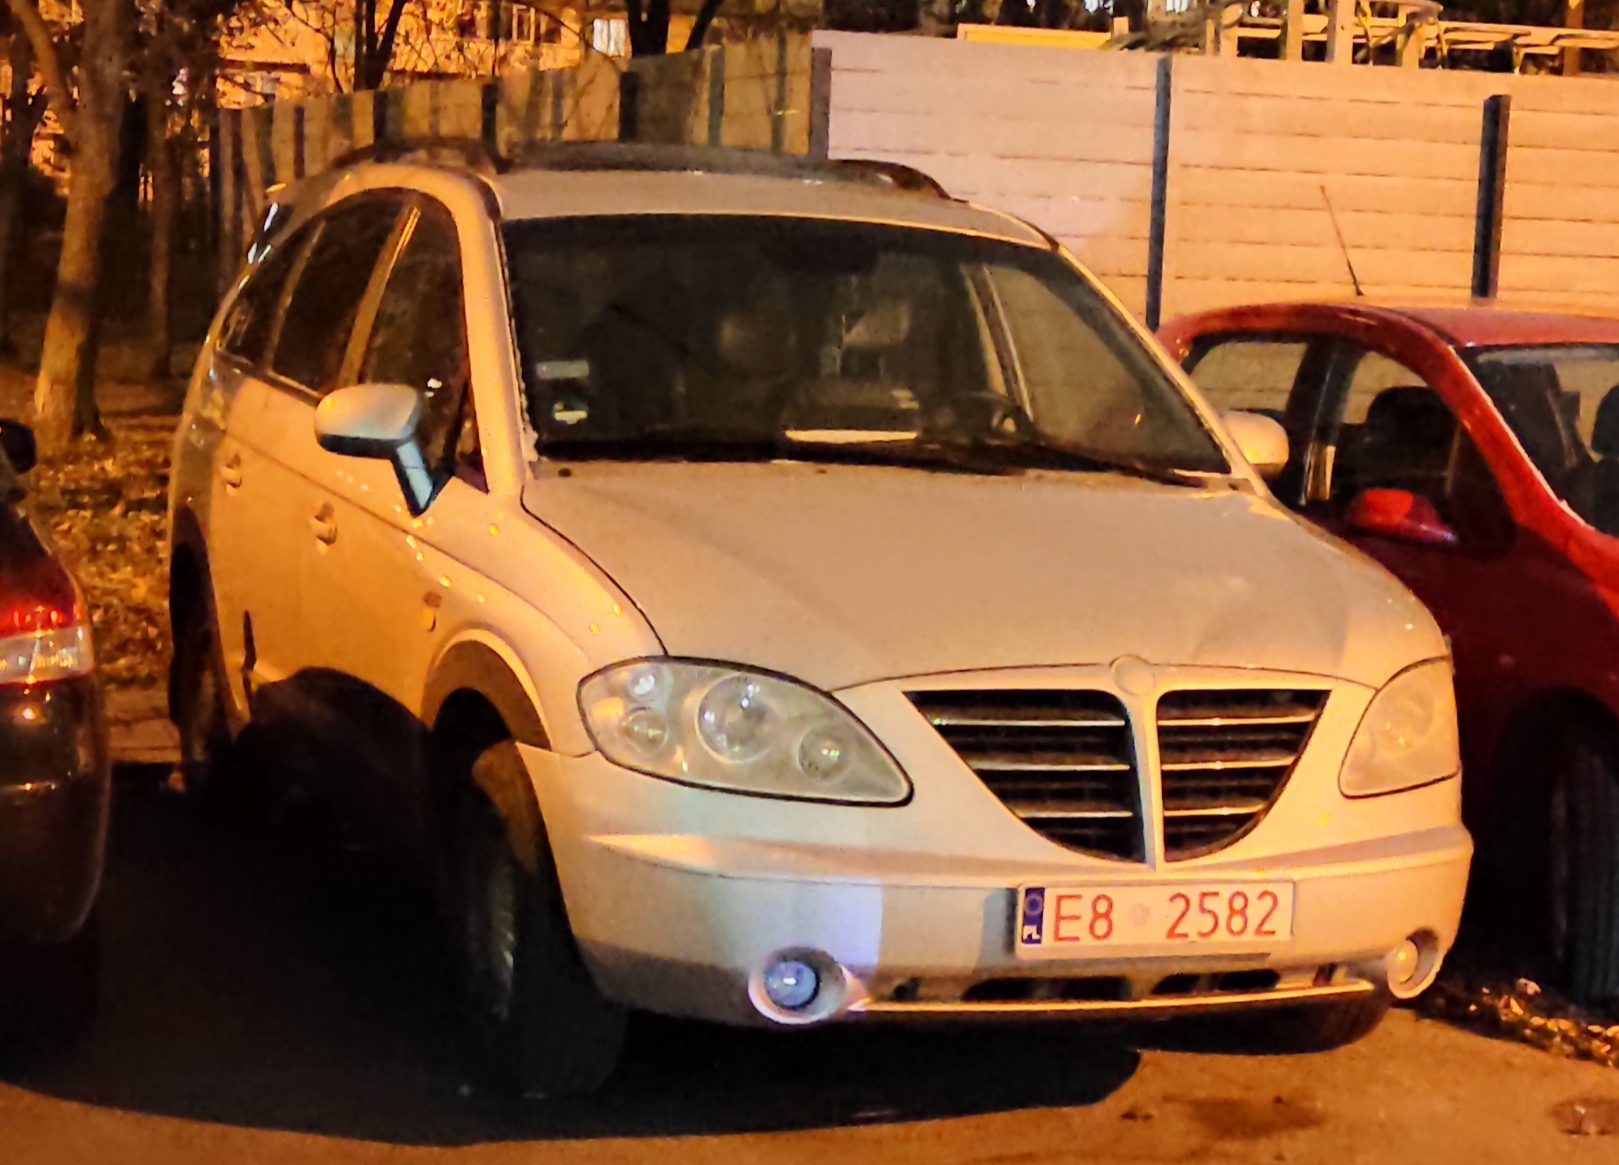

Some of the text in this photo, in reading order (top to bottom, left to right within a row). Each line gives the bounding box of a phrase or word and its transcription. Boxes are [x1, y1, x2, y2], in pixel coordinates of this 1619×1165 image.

[1022, 925, 1041, 940] PL
[1053, 890, 1279, 942] E8 2582
